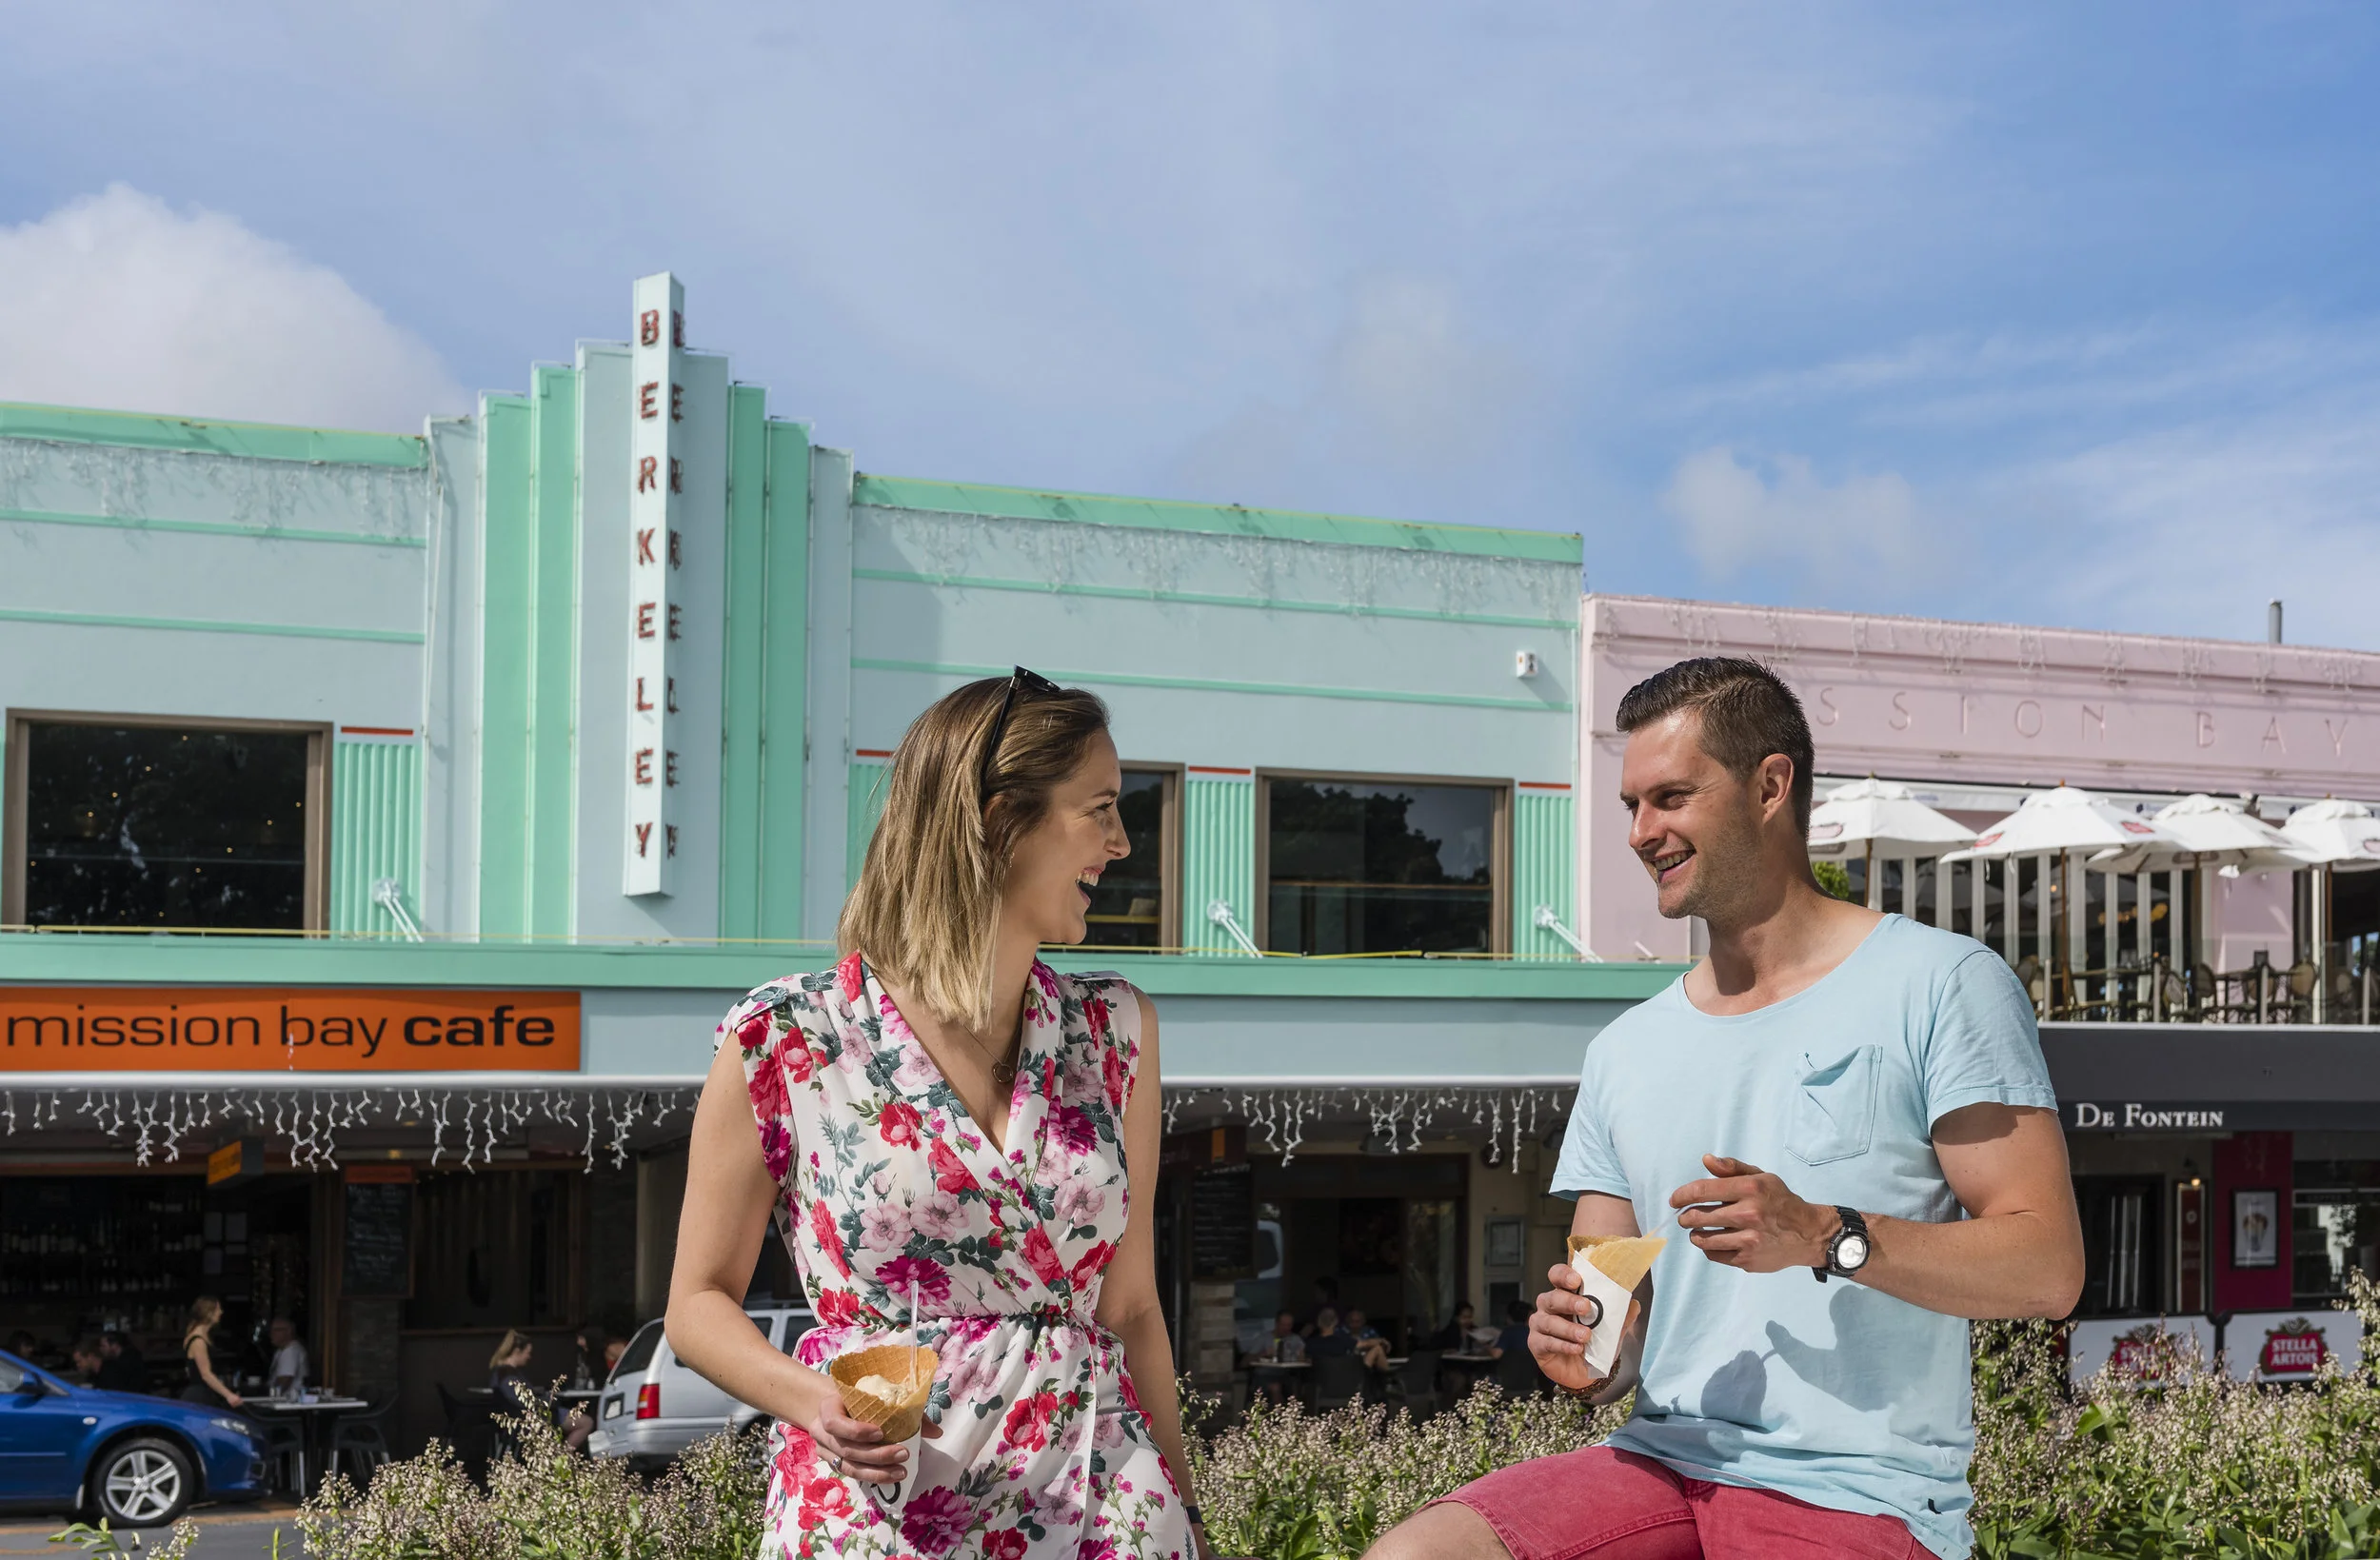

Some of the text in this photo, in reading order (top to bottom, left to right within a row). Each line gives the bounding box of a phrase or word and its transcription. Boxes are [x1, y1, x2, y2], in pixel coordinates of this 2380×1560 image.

[634, 309, 660, 858] BERKELEY
[1816, 686, 2349, 758] SSION BAY
[8, 1004, 555, 1057] mission bay cafe
[2271, 1337, 2318, 1352] STELLA
[2271, 1352, 2318, 1366] ARTOIS
